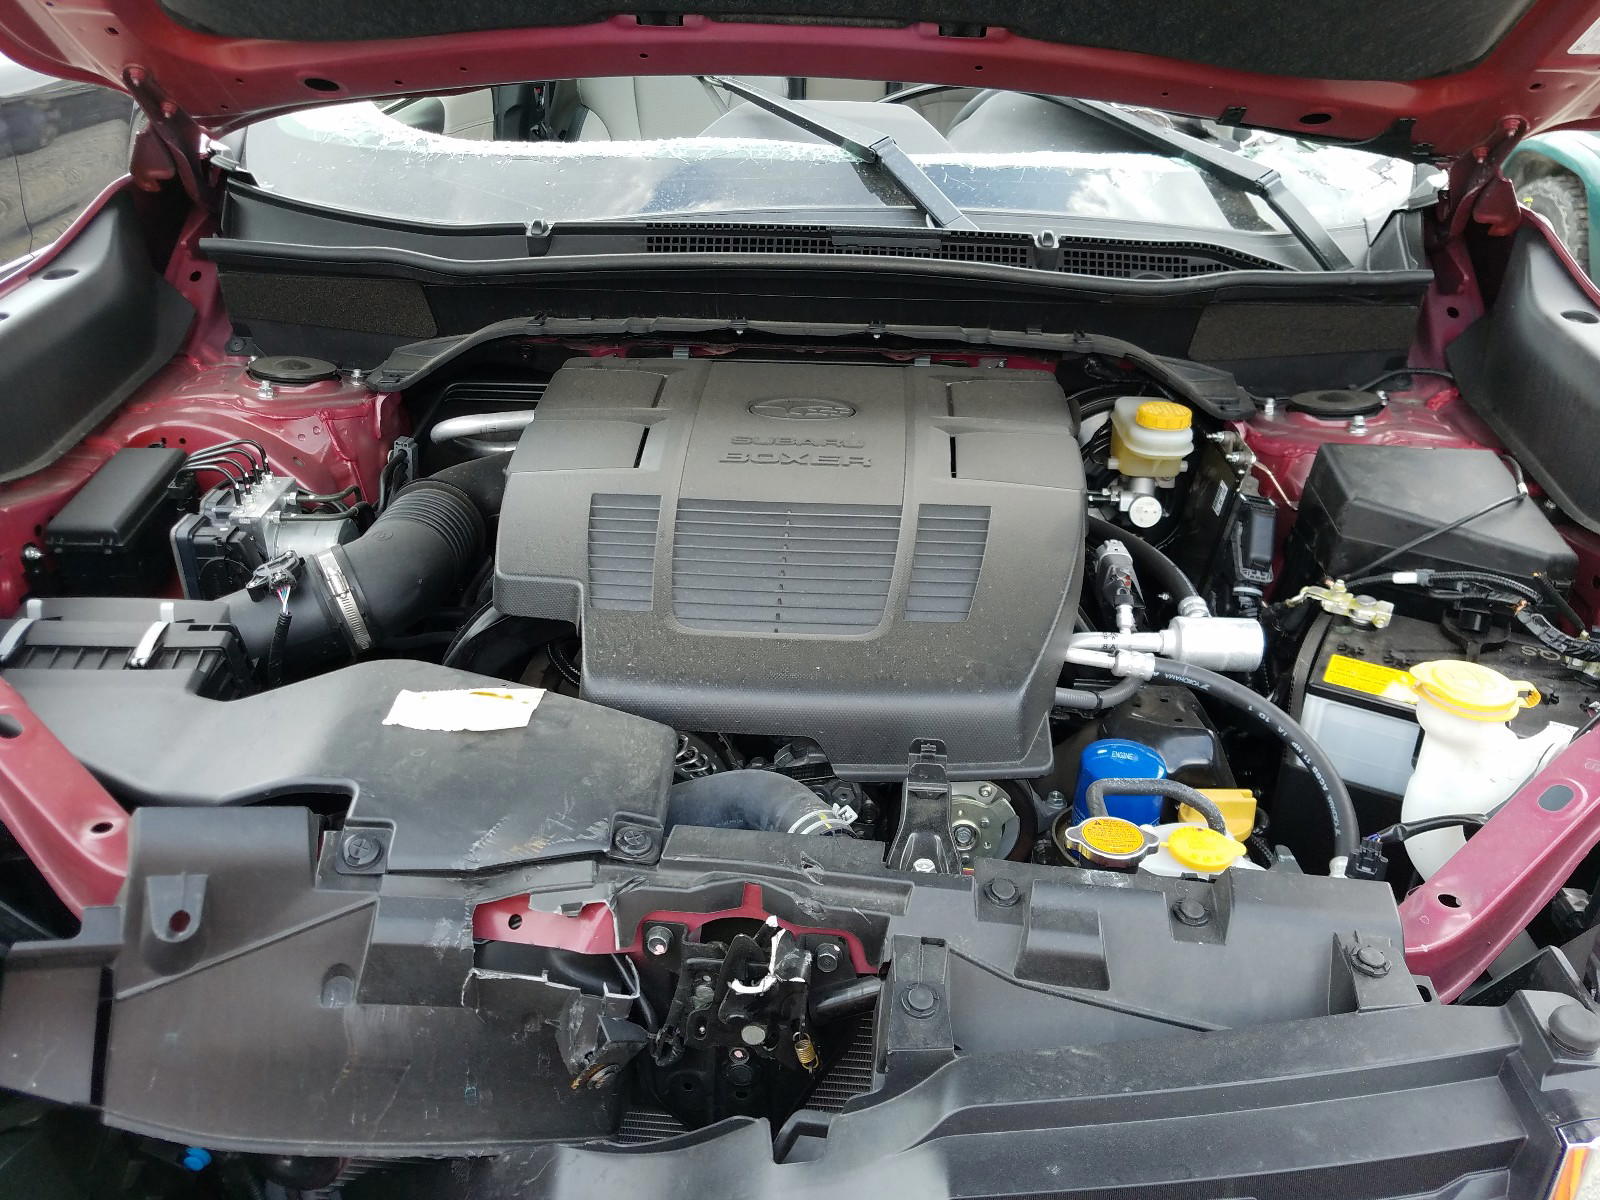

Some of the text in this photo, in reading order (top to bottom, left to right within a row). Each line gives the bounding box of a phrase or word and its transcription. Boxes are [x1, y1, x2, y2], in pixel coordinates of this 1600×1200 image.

[731, 436, 865, 448] SUBARU
[719, 453, 872, 467] BOXER
[1111, 750, 1134, 760] ENGINE
